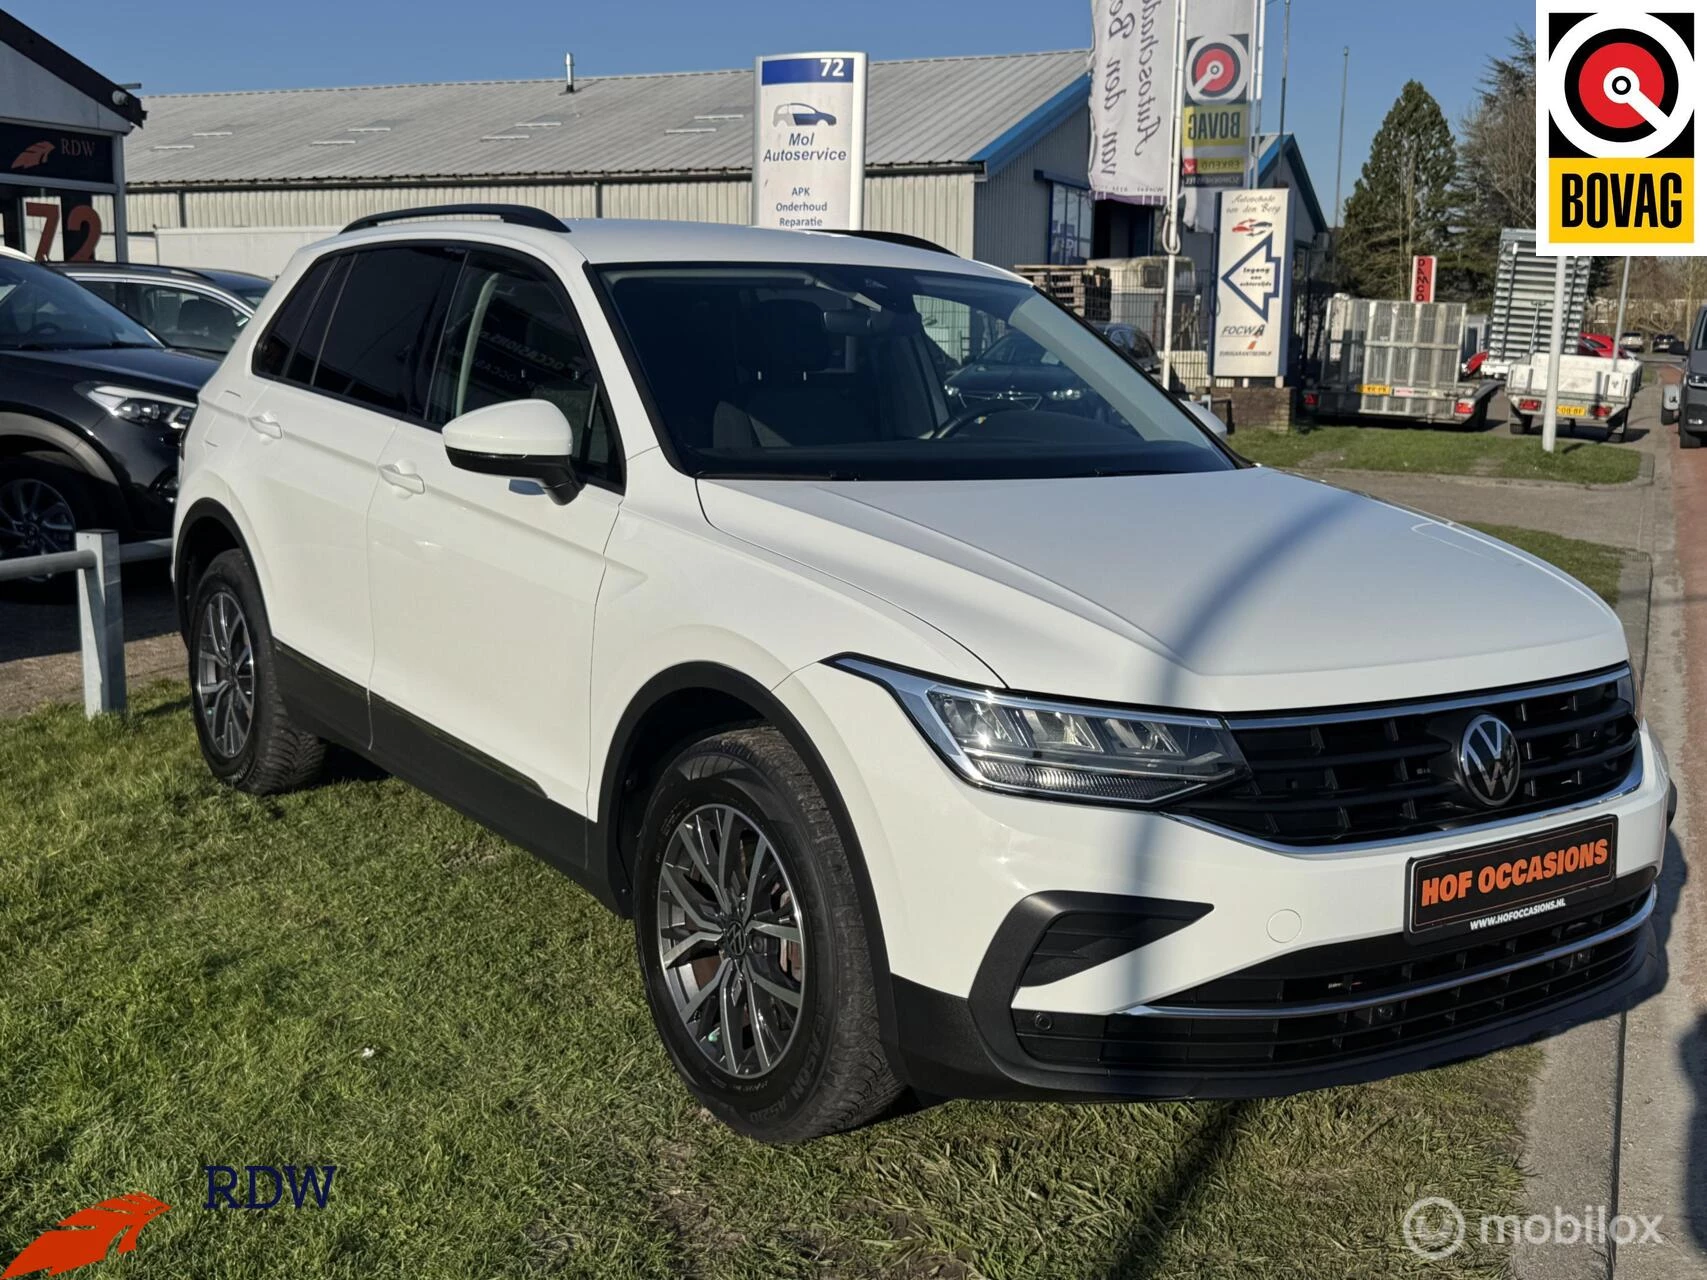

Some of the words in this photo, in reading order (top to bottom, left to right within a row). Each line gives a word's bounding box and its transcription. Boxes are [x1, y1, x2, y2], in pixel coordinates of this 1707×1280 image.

[820, 58, 845, 77] 72
[60, 138, 96, 157] RDW
[788, 132, 815, 147] Mol
[763, 147, 847, 162] Autoservice
[791, 187, 810, 196] APK
[775, 201, 828, 212] Onderhoud
[779, 216, 823, 228] Reparatie
[26, 202, 102, 262] 72
[1415, 258, 1430, 302] DAMCO
[1222, 323, 1266, 336] FOCWA
[1421, 871, 1473, 907] HOF
[1478, 838, 1609, 894] OCCASIONS
[1470, 897, 1566, 931] WWW.HOFOCCASIONS.NL
